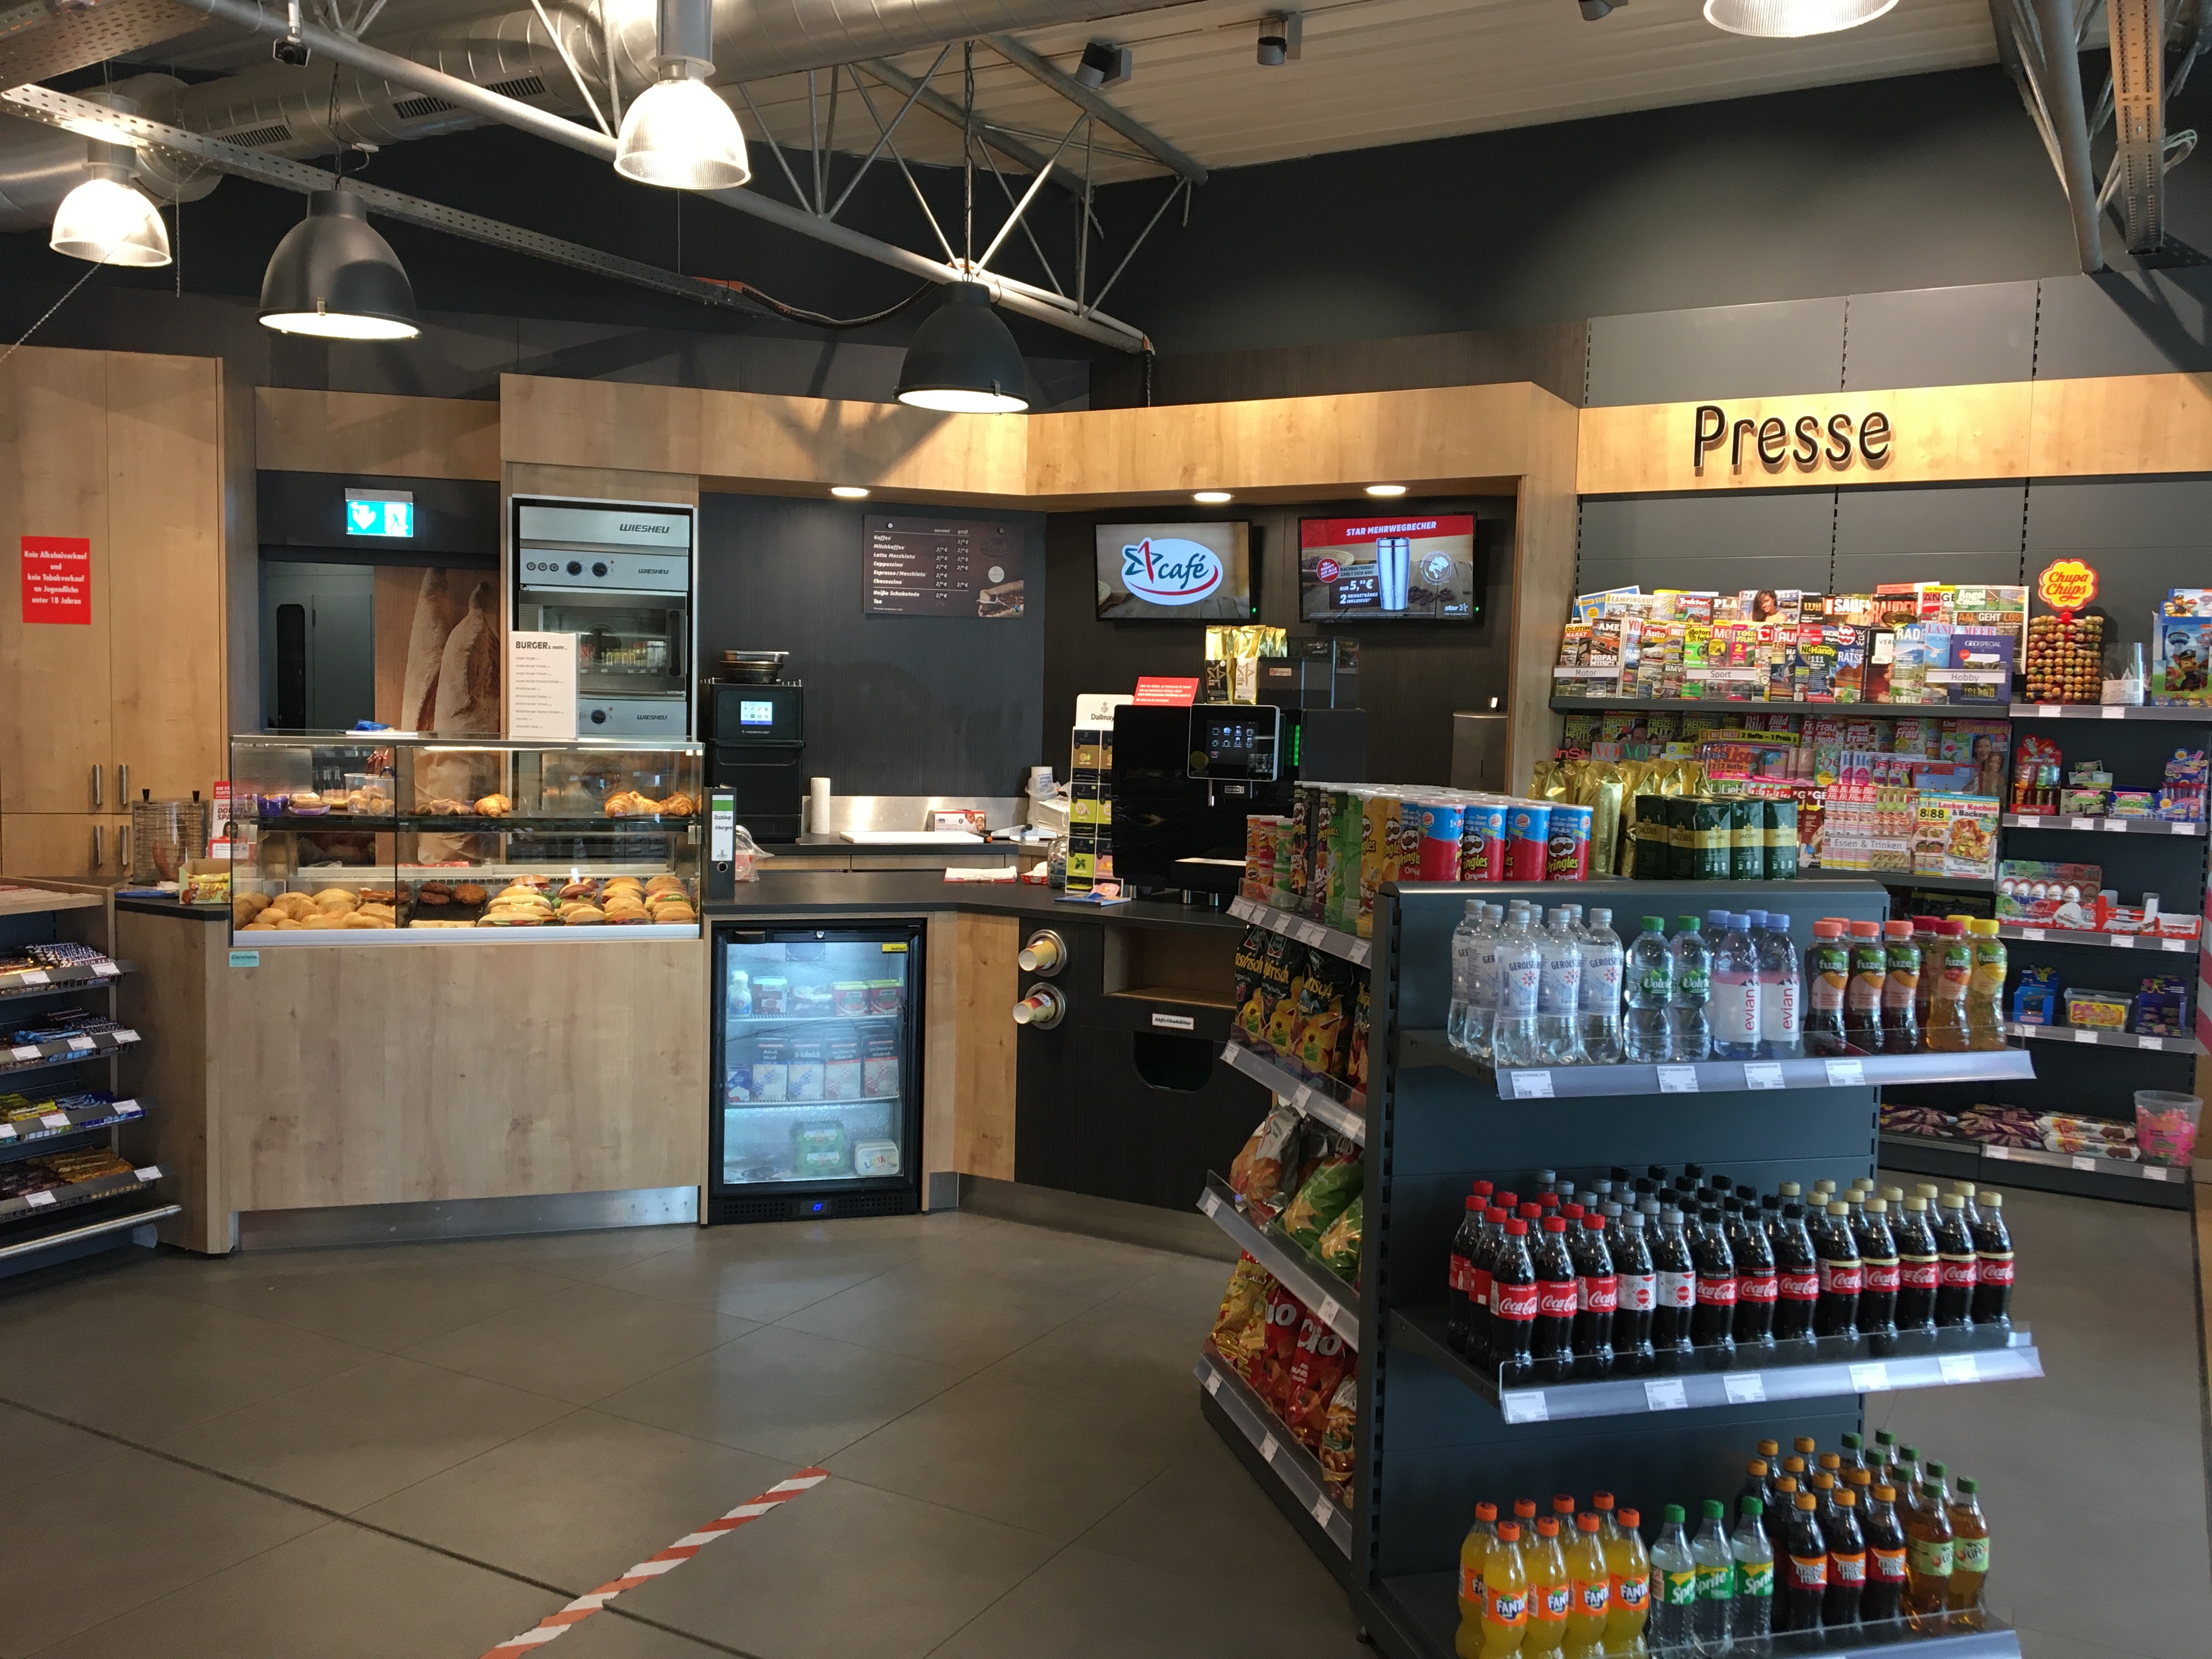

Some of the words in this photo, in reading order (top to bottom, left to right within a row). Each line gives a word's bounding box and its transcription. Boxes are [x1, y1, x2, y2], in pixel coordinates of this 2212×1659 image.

[1694, 405, 1889, 468] Presse
[619, 524, 670, 534] WIESHEU
[1346, 527, 1365, 536] STAR
[1367, 521, 1436, 534] MEHRWEGBECHER
[40, 551, 87, 560] Alkoholverkauf
[1158, 553, 1209, 589] café
[2049, 571, 2089, 585] Chupa
[43, 585, 78, 594] Jugendliche
[1959, 589, 1985, 599] Angel
[2046, 583, 2087, 601] Chups
[1340, 594, 1346, 603] 2
[1951, 673, 1979, 681] Hobby
[1604, 719, 1632, 727] FREIZEIT
[1769, 715, 1788, 725] Bild
[1816, 721, 1836, 731] Frau
[1847, 732, 1867, 742] Frau
[1895, 729, 1917, 738] Frau
[1671, 832, 1692, 842] JACOBS
[1871, 840, 1901, 849] Trinken
[1644, 978, 1672, 988] Volvic
[1745, 988, 1756, 1031] evian
[1782, 988, 1793, 1030] evian
